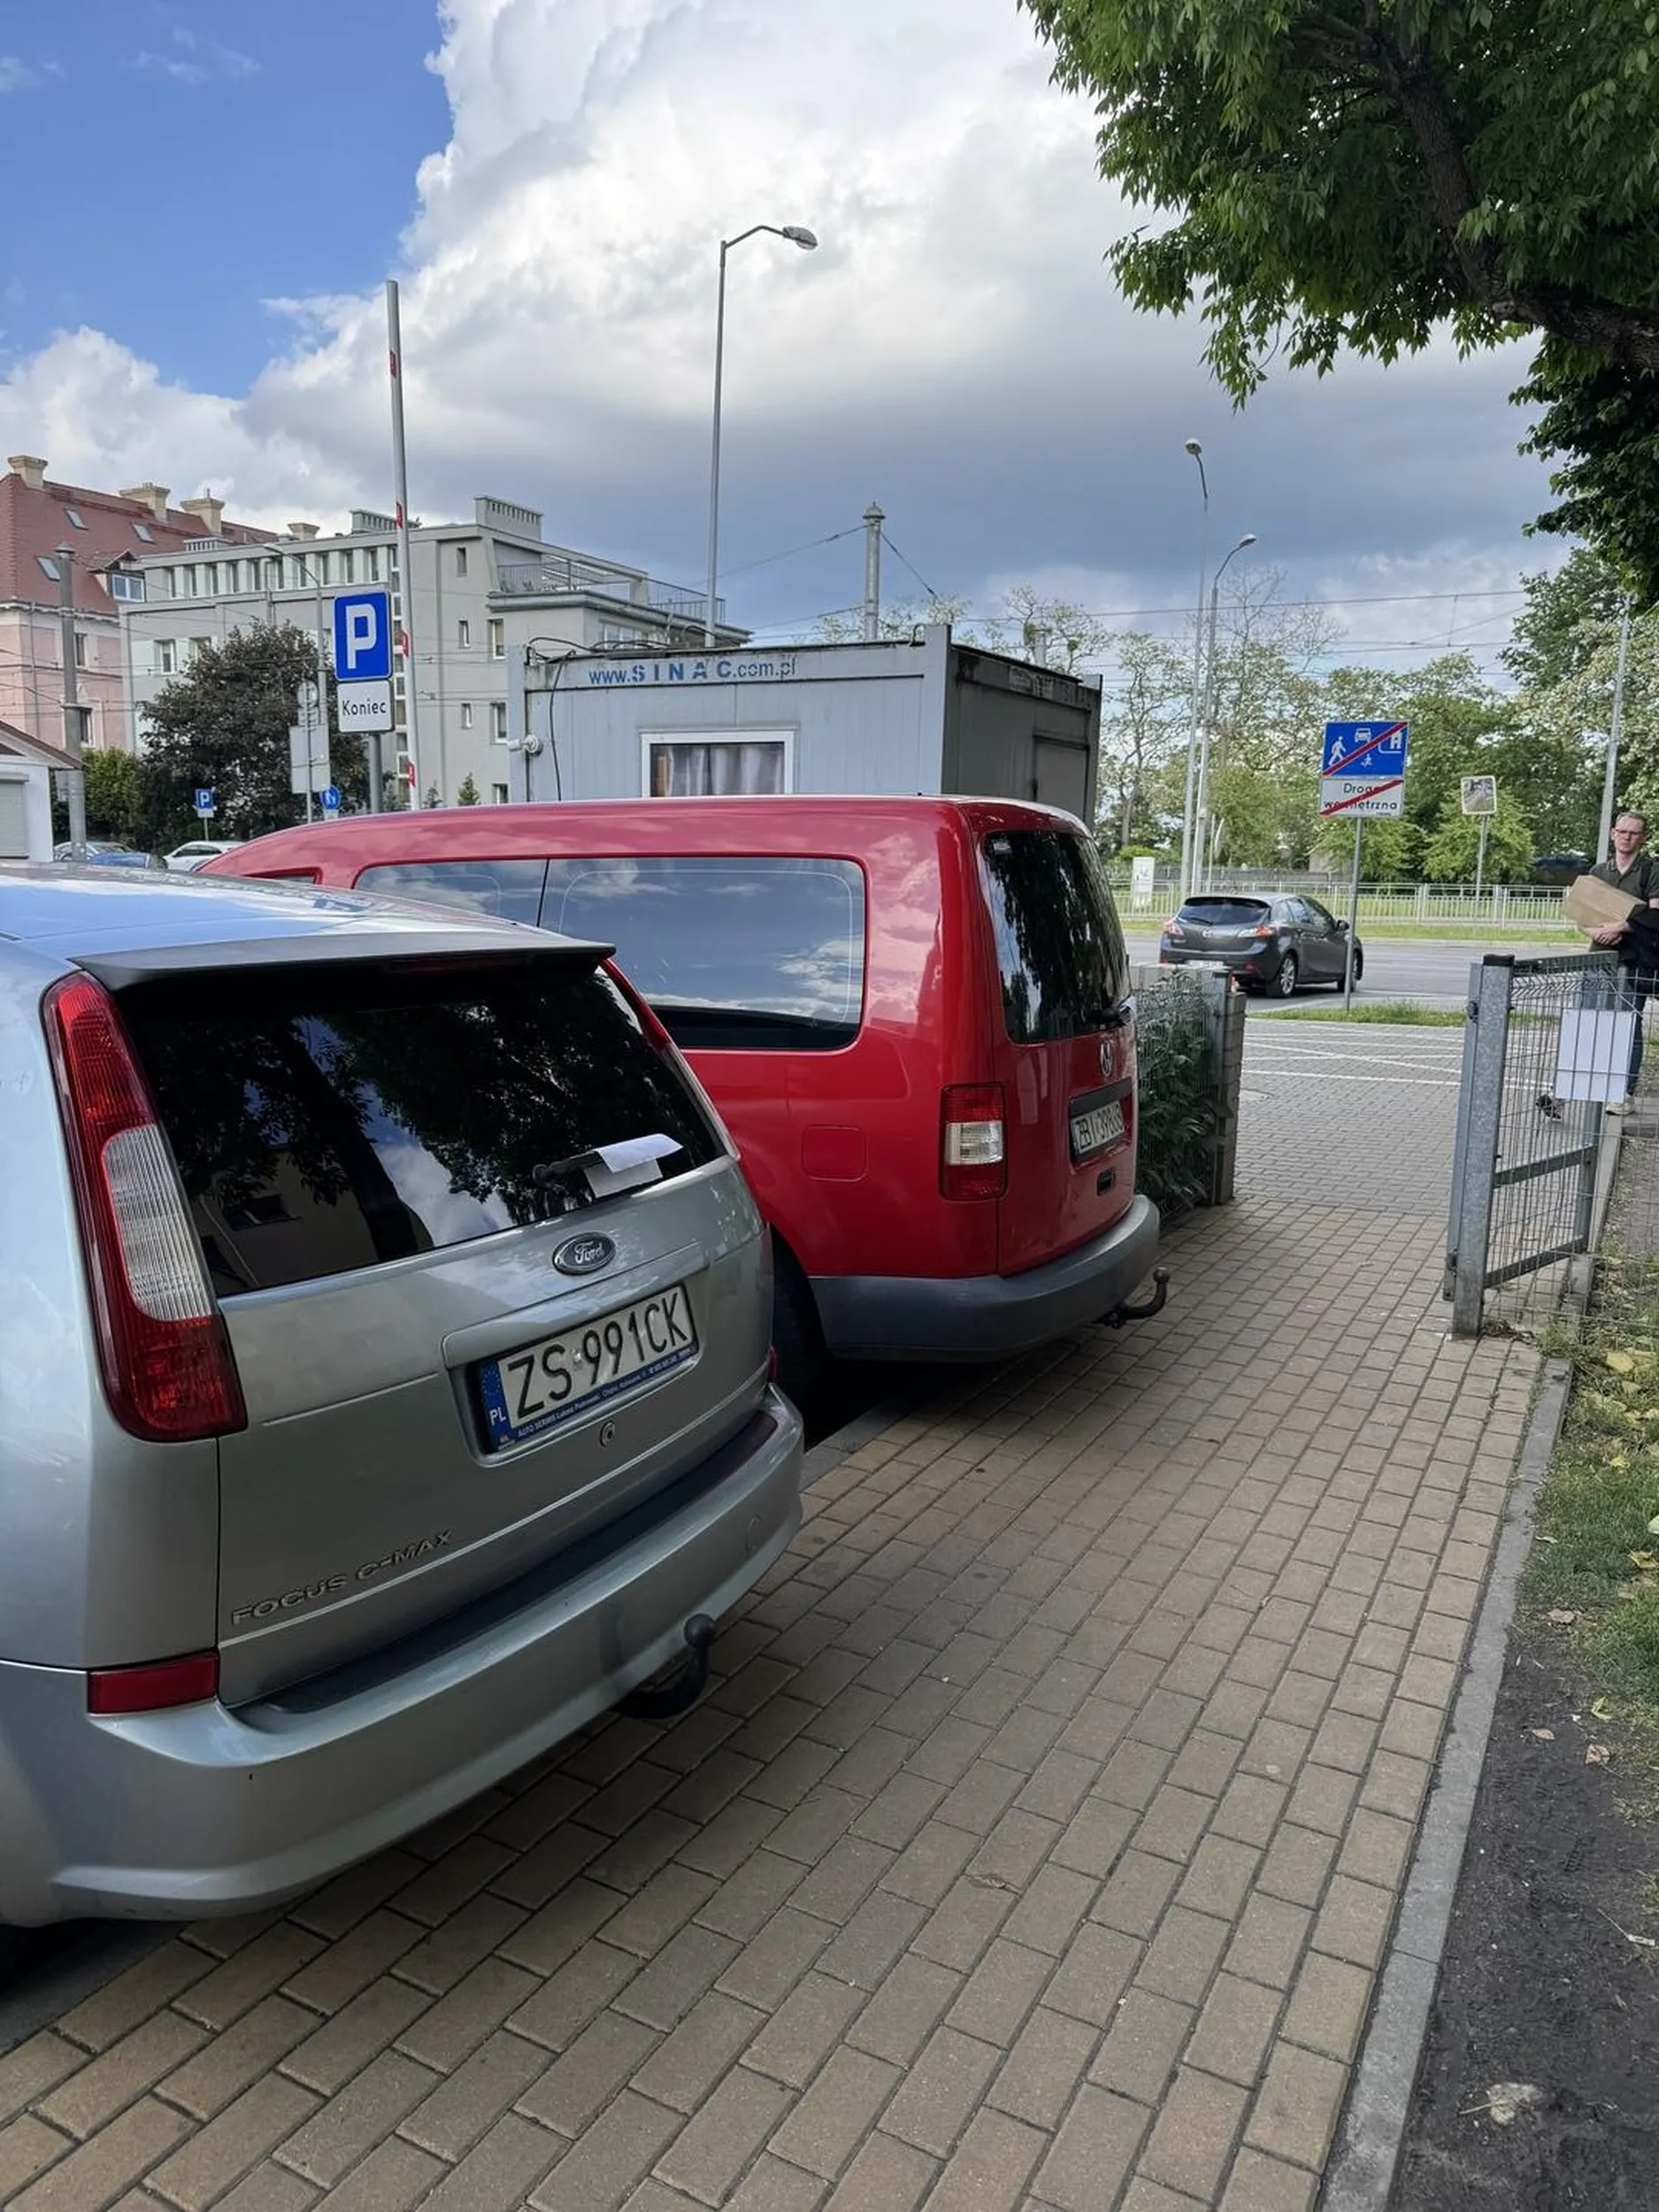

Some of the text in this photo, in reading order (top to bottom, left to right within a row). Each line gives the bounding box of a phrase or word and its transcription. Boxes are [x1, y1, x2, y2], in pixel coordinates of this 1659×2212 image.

[345, 603, 377, 670] P
[342, 698, 387, 717] Koniec
[200, 792, 210, 806] P
[1343, 783, 1380, 797] Drog
[574, 1240, 603, 1264] Ford
[489, 1407, 507, 1425] PL
[232, 1528, 453, 1625] FOCUS C-MAX
